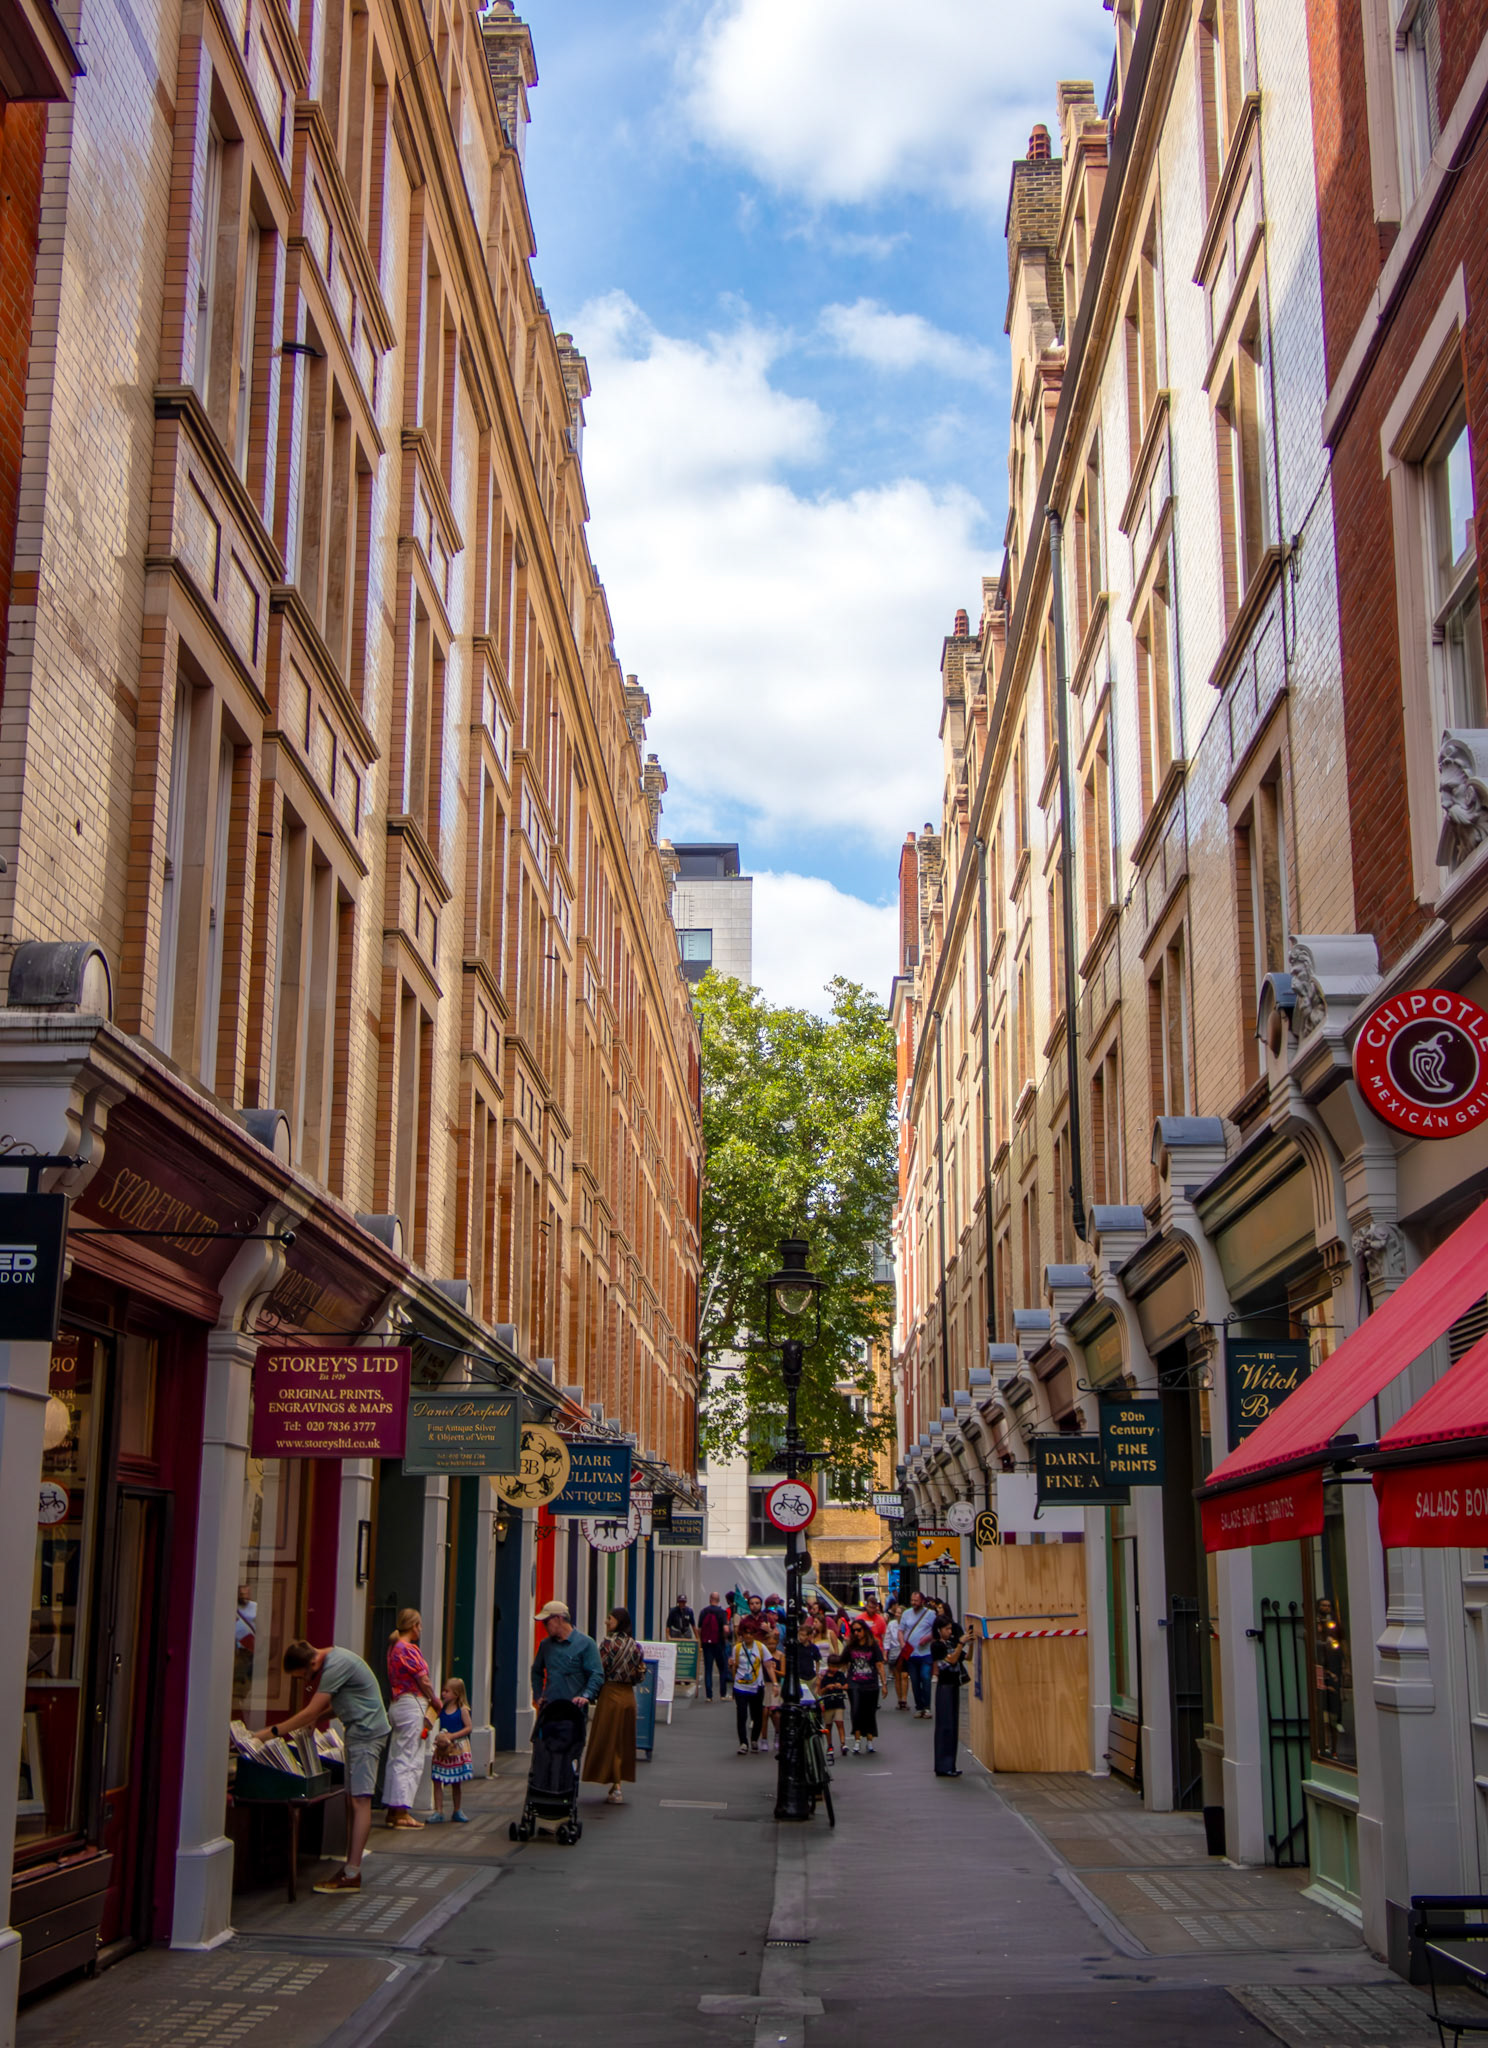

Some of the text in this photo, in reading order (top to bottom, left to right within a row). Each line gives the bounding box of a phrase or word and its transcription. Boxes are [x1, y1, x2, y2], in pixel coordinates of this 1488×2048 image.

[1369, 1075, 1449, 1128] MEXICAN
[0, 1272, 35, 1284] DON
[268, 1357, 398, 1372] STOREY'S LTD
[1238, 1364, 1298, 1389] Witch
[279, 1389, 384, 1400] ORIGINAL PRINTS,
[269, 1403, 393, 1413] ENGRAVINGS & MAPS
[413, 1402, 511, 1420] Daniel Bexfield
[1120, 1412, 1145, 1421] 20th
[283, 1421, 376, 1431] Tel: 020 7836 3777
[445, 1424, 473, 1432] Antique
[1109, 1425, 1155, 1436] Century
[437, 1433, 464, 1441] Objects
[276, 1438, 380, 1450] www.storeysltd.co.uk
[1117, 1443, 1149, 1455] FINE
[571, 1455, 611, 1466] MARK
[1045, 1452, 1100, 1465] DARNL
[1110, 1460, 1157, 1472] PRINTS
[567, 1472, 623, 1483] ULLIVAN
[1046, 1476, 1085, 1488] FINE
[557, 1491, 622, 1504] ANTIQUES
[1415, 1489, 1459, 1518] SALADS
[789, 1599, 796, 1608] 2
